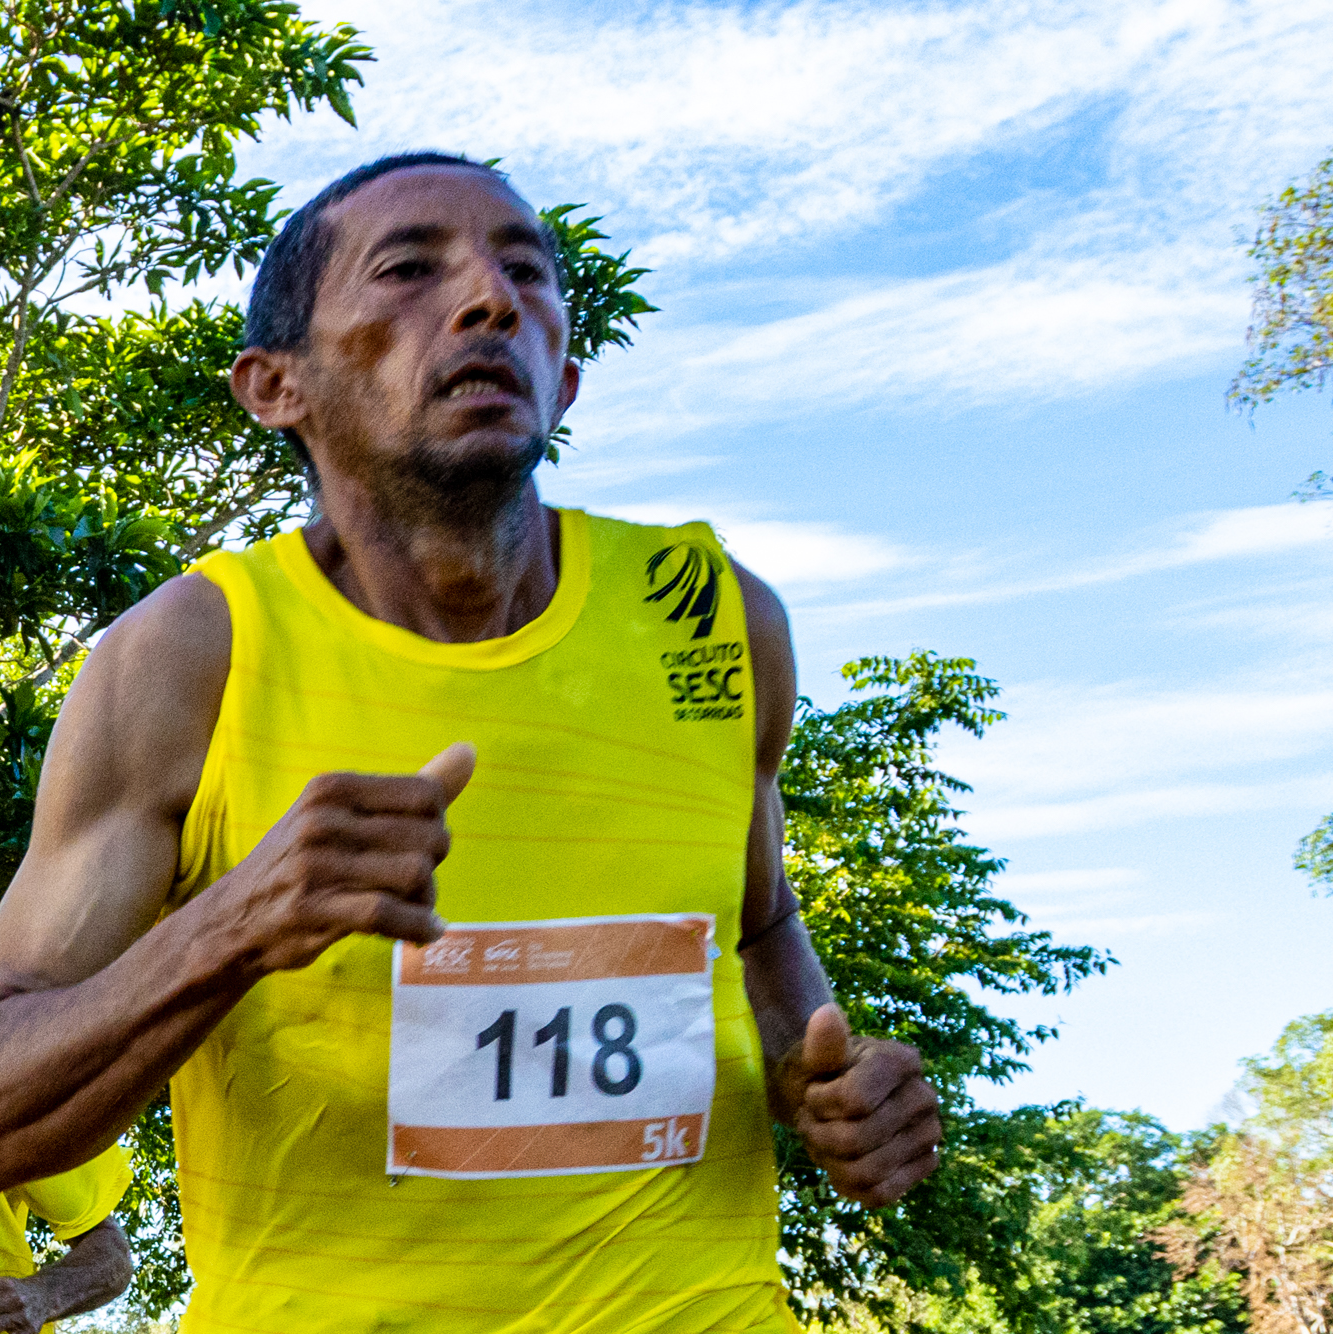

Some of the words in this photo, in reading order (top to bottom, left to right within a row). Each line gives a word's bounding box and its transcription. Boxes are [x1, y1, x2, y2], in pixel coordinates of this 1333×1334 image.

[660, 641, 744, 669] CIRCUITO
[667, 666, 743, 704] SESC
[476, 1002, 643, 1101] 118
[641, 1117, 688, 1162] 5k
